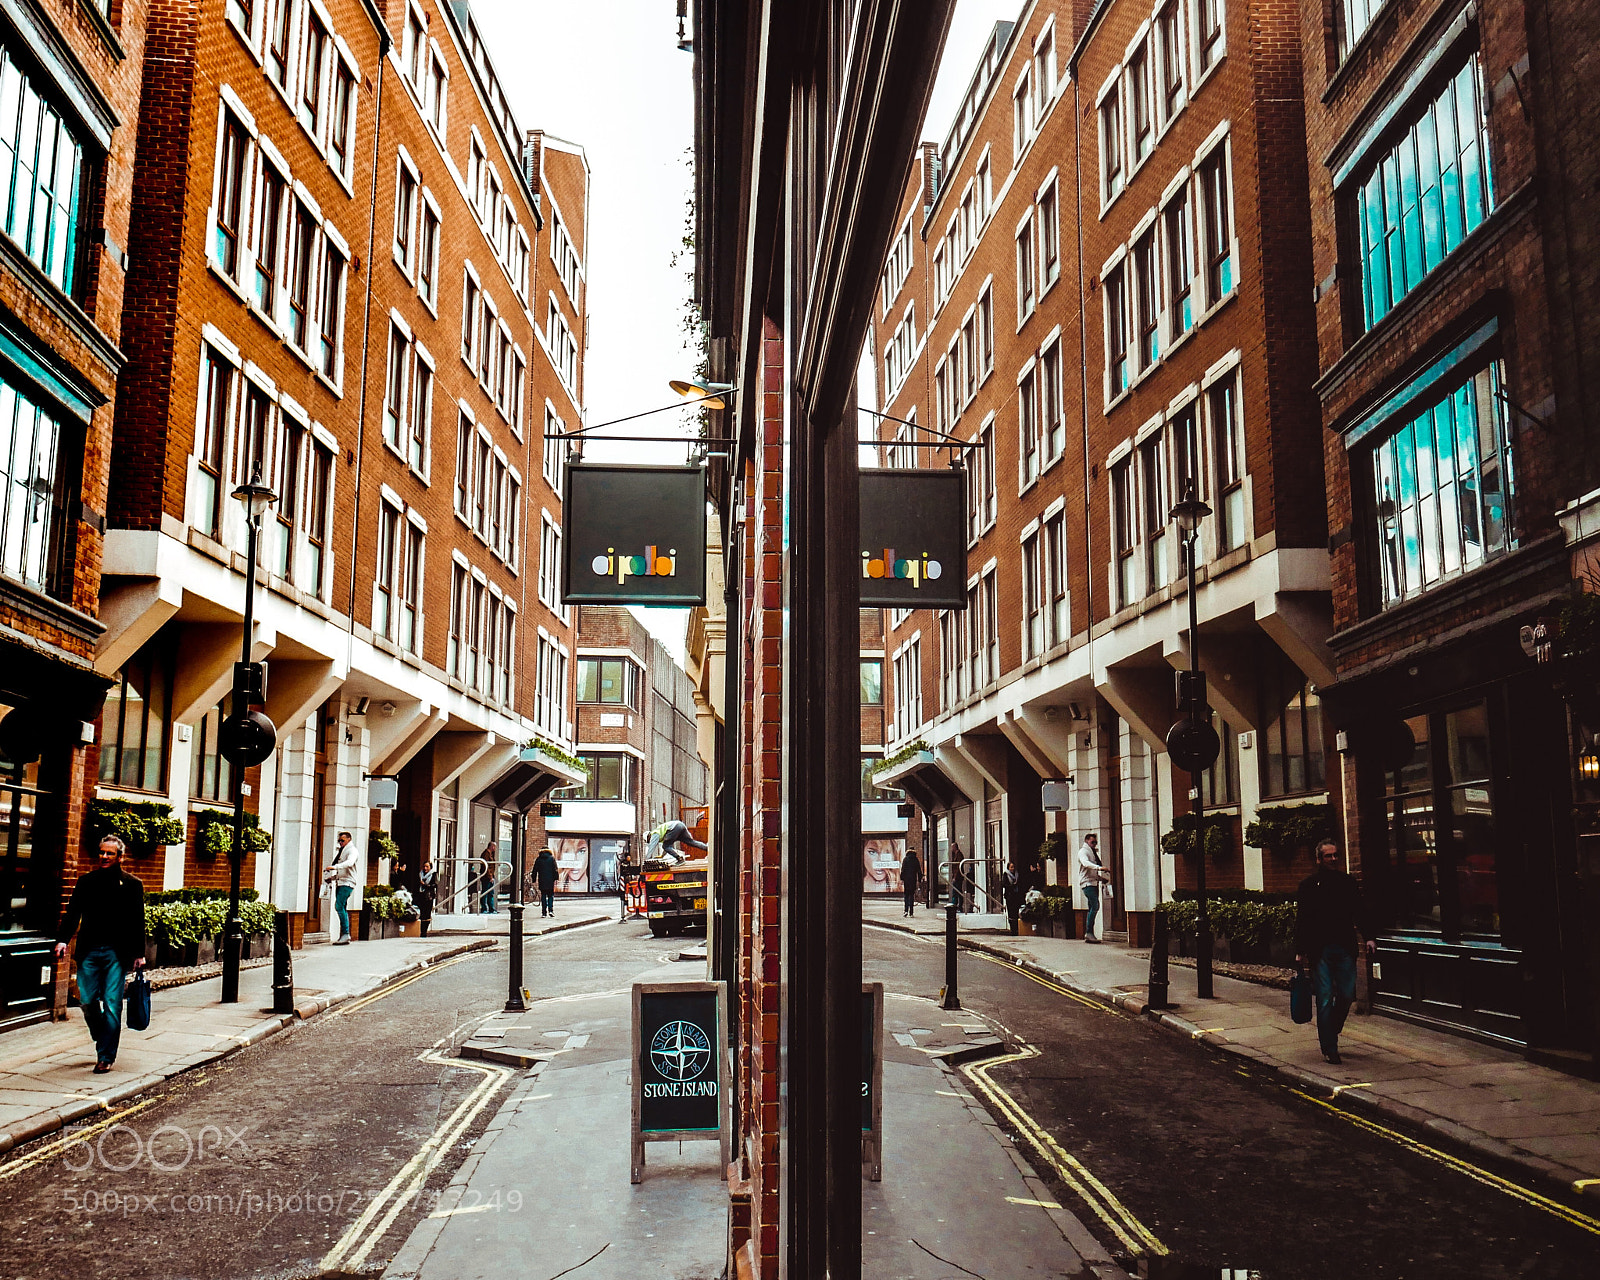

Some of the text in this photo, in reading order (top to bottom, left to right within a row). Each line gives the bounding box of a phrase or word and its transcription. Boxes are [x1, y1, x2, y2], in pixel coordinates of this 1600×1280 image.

[654, 1024, 707, 1049] STONE ISLAND
[657, 1060, 701, 1075] SS 18
[644, 1081, 717, 1098] STONE ISLAND
